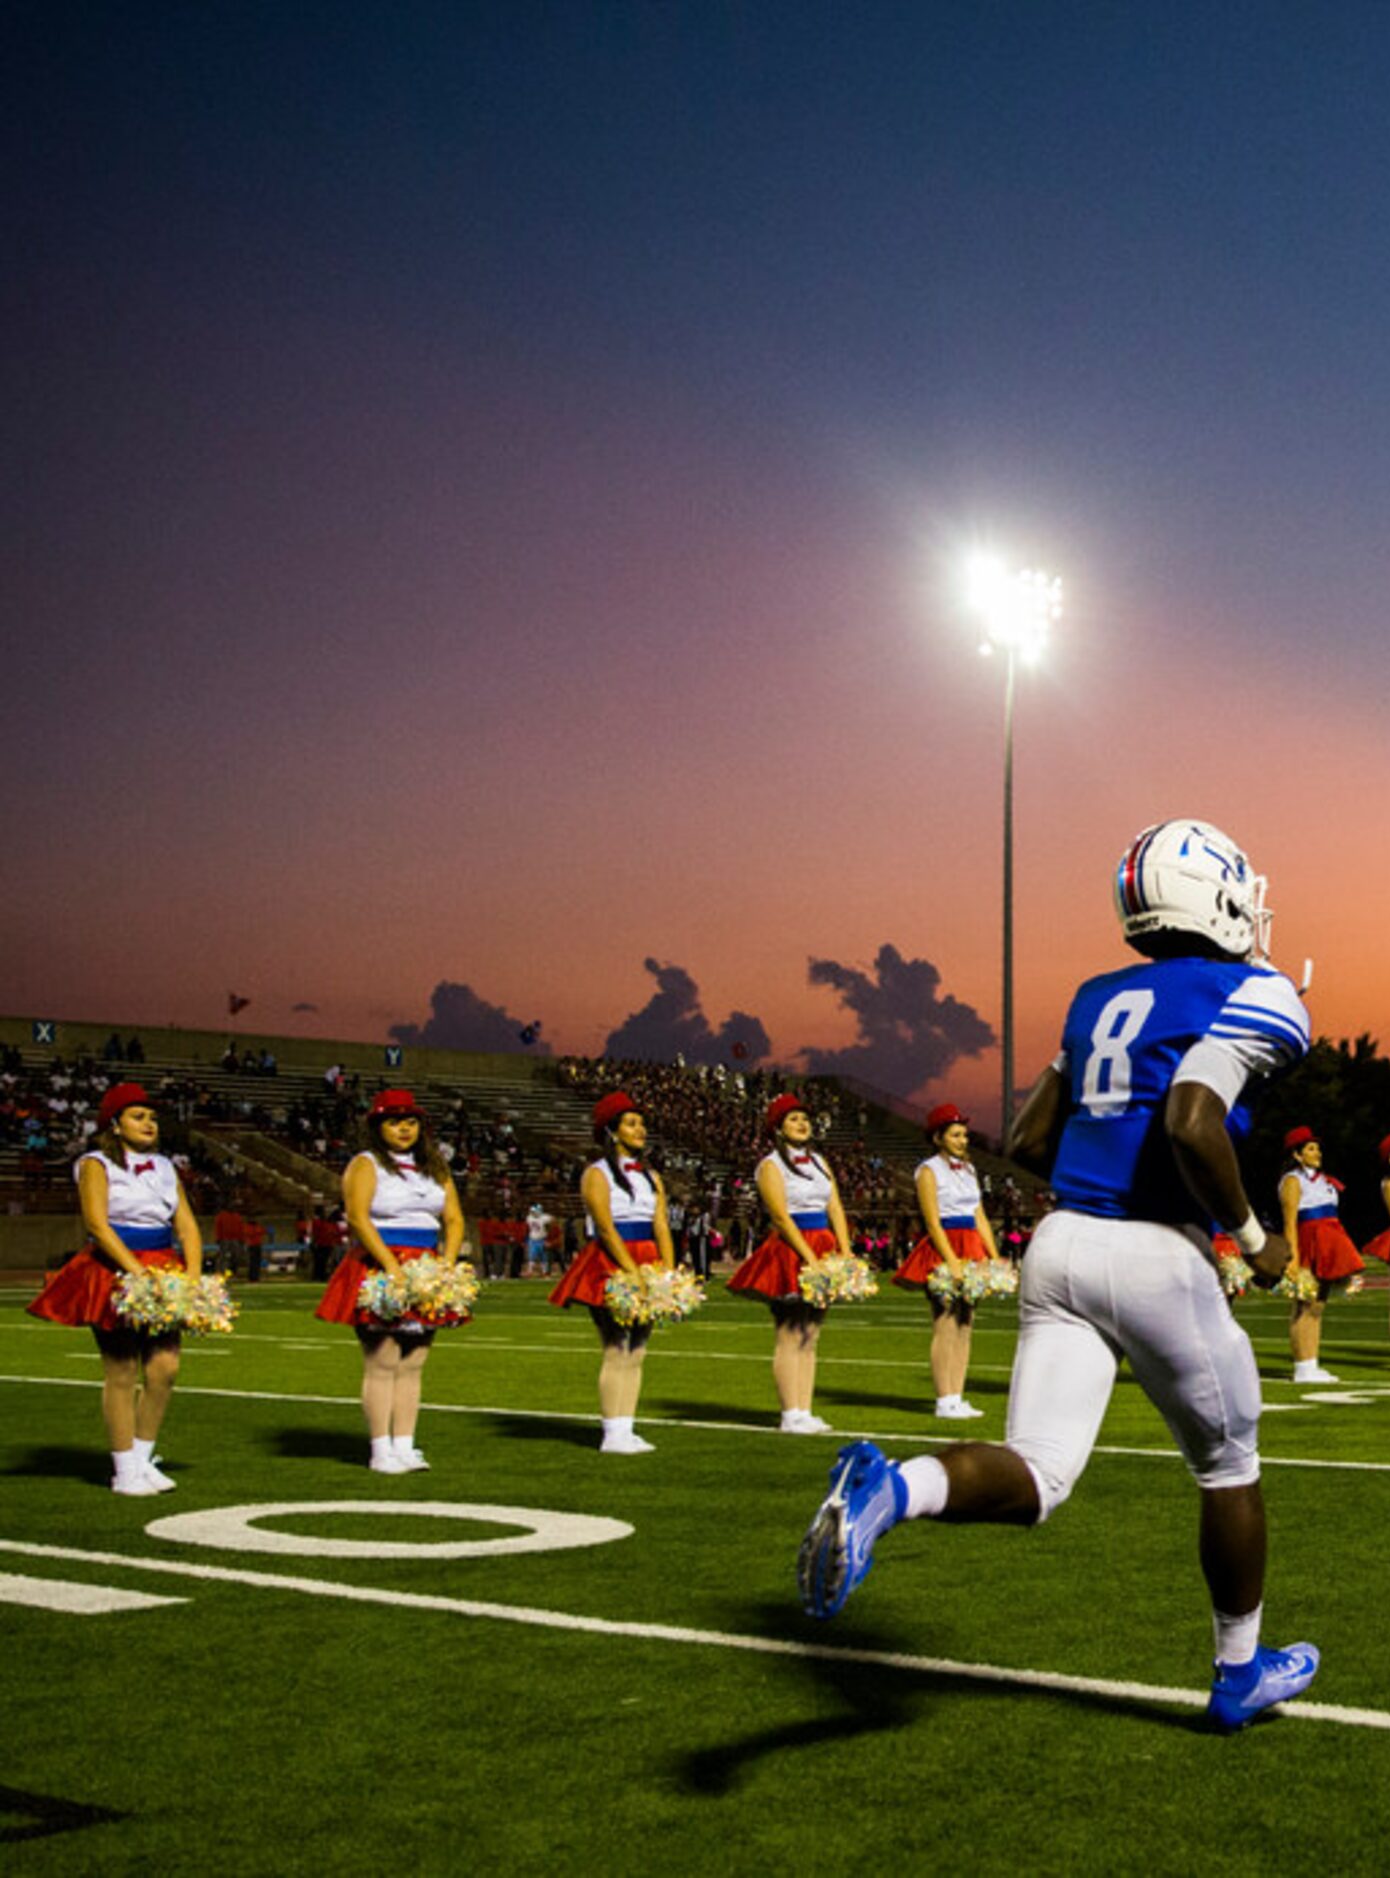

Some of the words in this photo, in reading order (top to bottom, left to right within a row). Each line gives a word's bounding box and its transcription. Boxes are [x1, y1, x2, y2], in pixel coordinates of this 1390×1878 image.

[36, 1022, 52, 1041] X
[387, 1047, 400, 1065] Y
[1081, 988, 1156, 1117] 8
